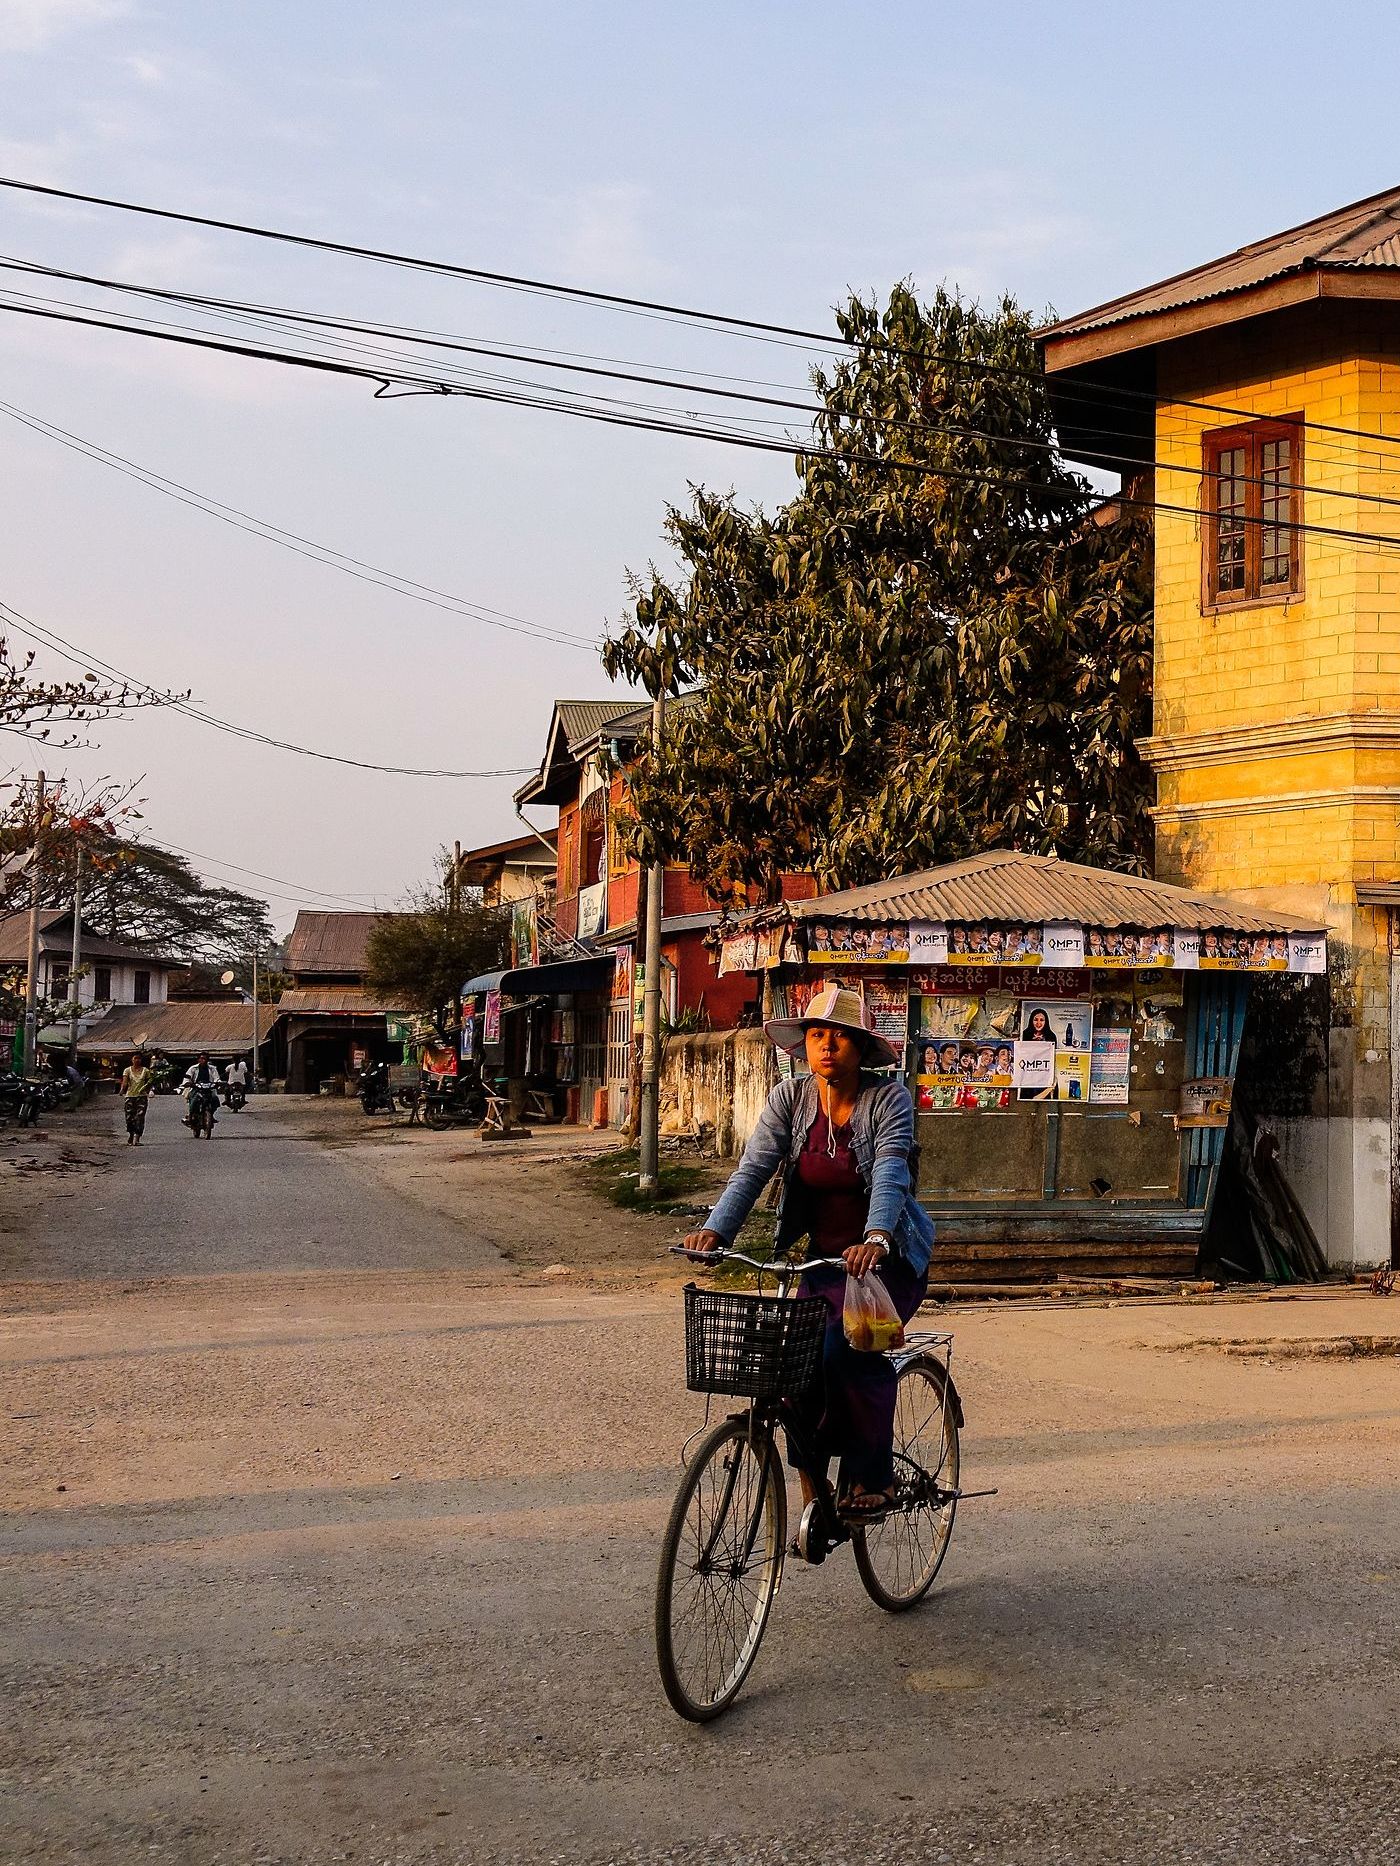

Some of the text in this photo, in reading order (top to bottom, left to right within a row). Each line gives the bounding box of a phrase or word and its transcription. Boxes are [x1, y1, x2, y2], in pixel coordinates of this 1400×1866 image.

[922, 935, 947, 944] MPT
[1056, 940, 1081, 948] MPT
[1187, 942, 1199, 950] MP
[1300, 946, 1321, 955] MPT
[1026, 1060, 1050, 1069] MPT
